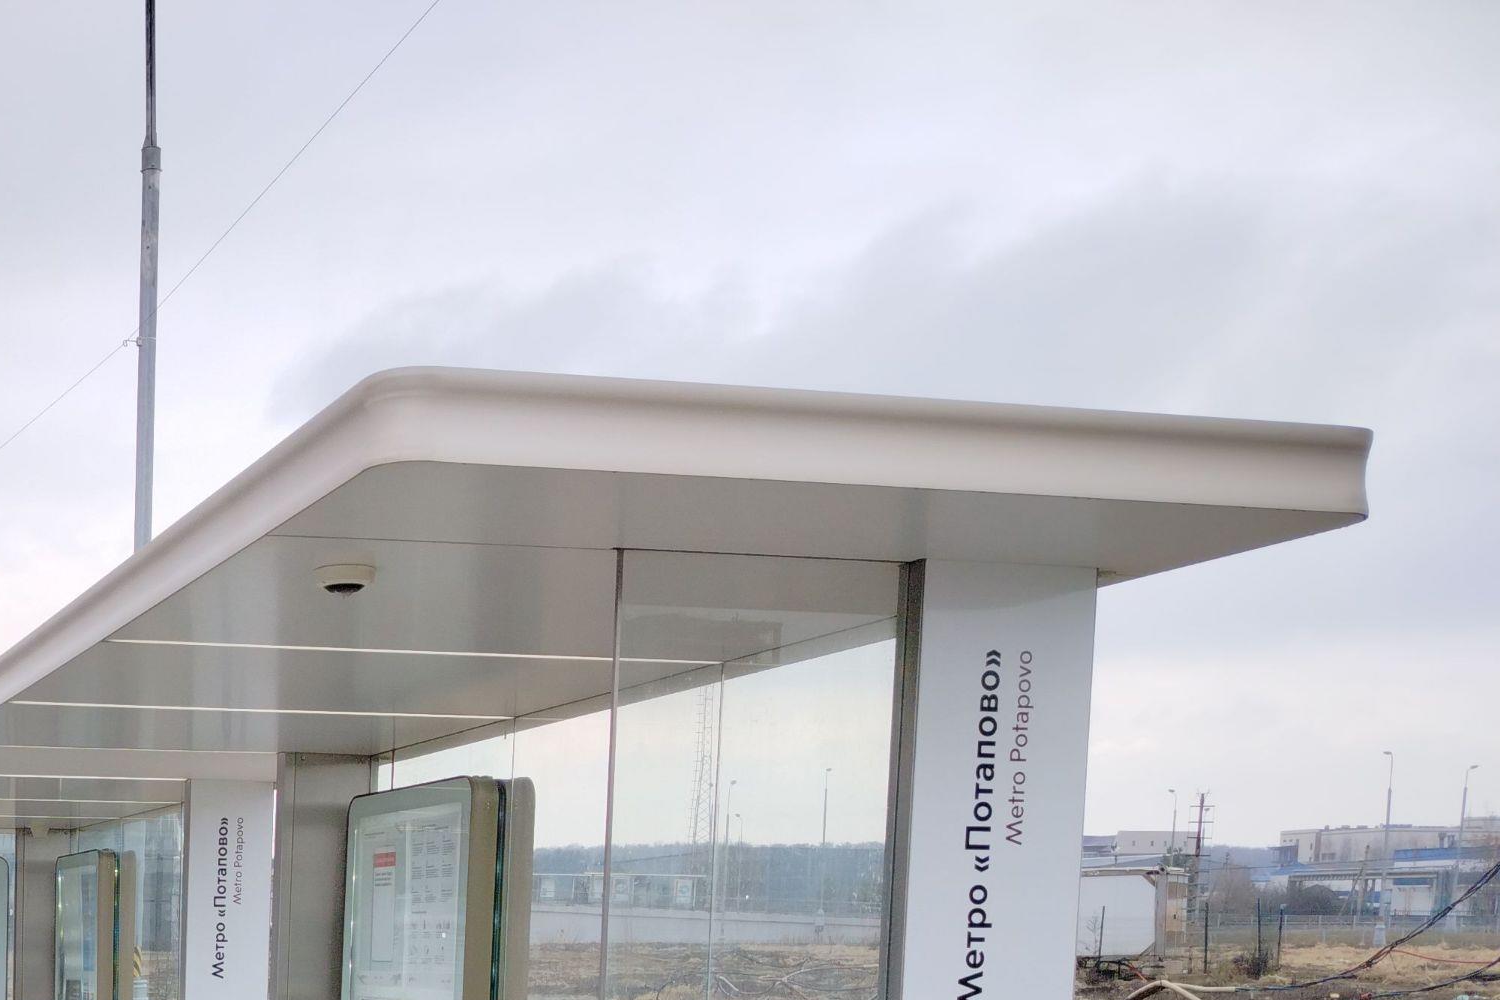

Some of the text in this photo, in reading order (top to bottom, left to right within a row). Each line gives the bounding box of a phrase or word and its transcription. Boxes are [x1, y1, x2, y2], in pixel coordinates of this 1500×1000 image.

[964, 648, 1001, 874] «Потапово»
[1005, 649, 1035, 846] Metro Potapovo
[211, 817, 229, 979] Метро «Потапово»
[233, 817, 245, 905] Metro Potapovo
